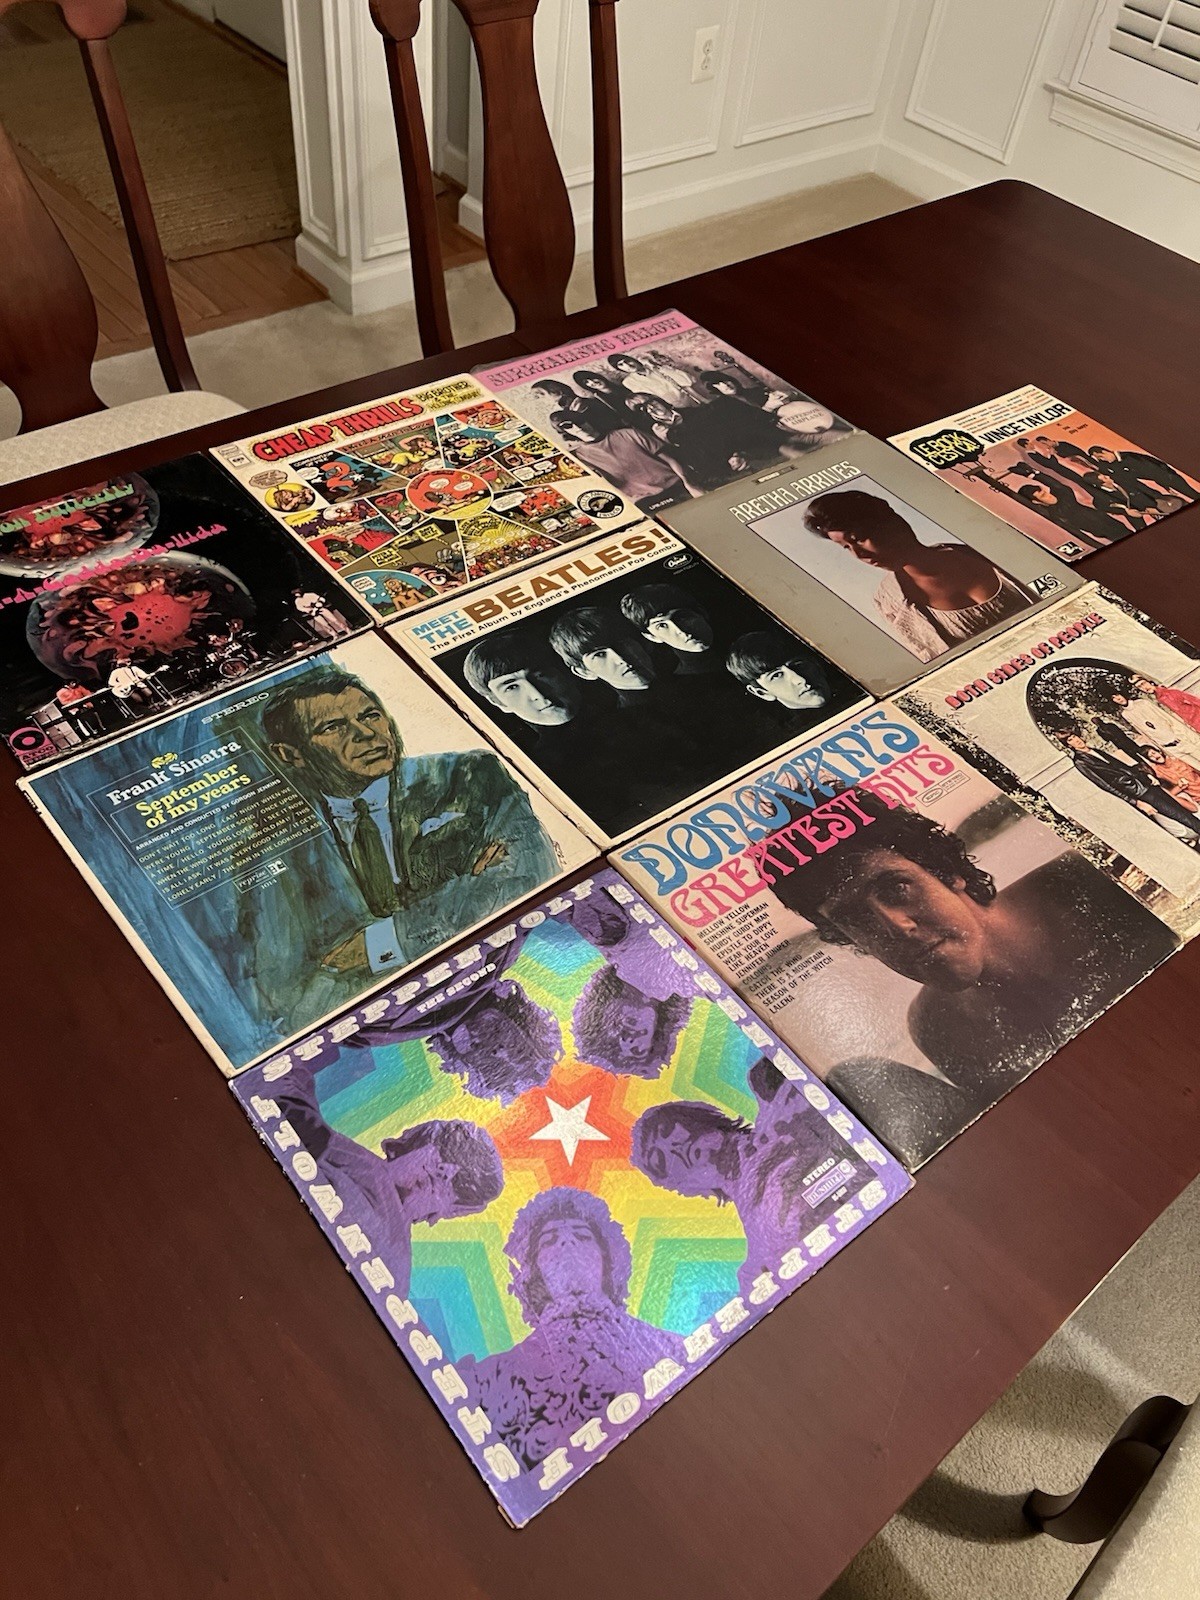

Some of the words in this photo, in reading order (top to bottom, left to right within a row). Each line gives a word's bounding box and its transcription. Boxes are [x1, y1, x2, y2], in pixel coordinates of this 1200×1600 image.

[489, 337, 615, 388] SURREALISTIC
[621, 318, 682, 350] PILLOW
[252, 425, 335, 462] CHEAP
[326, 397, 424, 436] THRILLS
[913, 443, 936, 457] LE
[978, 423, 1026, 444] VINCE
[1017, 403, 1072, 428] TAYLOR
[729, 487, 796, 523] ARETHA
[789, 461, 862, 498] ARRIVES
[430, 640, 450, 652] The
[452, 628, 476, 646] First
[478, 615, 509, 634] Album
[510, 608, 523, 621] by
[524, 589, 570, 612] England's
[571, 562, 627, 592] Phenomenal
[628, 554, 646, 569] Pop
[646, 542, 678, 558] Combo
[462, 528, 672, 624] BEATLES!
[412, 610, 460, 636] MEET
[420, 618, 474, 645] THE
[986, 653, 1037, 685] SIDES
[1030, 642, 1055, 659] OF
[1049, 612, 1107, 651] PEOPLE
[201, 692, 270, 725] STEREO
[106, 770, 172, 806] Frank
[171, 740, 242, 778] Sinatra
[136, 763, 240, 817] September
[135, 832, 169, 850] ARRANGED
[170, 826, 184, 834] AND
[184, 807, 221, 827] CONDUCTED
[231, 791, 256, 806] GORDON
[257, 779, 281, 793] JENKINS
[139, 849, 162, 862] DON'T
[162, 839, 180, 852] WAIT
[181, 832, 195, 842] TOO
[196, 823, 216, 836] LONG
[222, 812, 238, 823] LAST
[239, 802, 260, 815] NIGHT
[261, 791, 281, 804] WHEN
[145, 811, 165, 829] of
[165, 796, 198, 820] my
[198, 774, 251, 807] years
[620, 710, 921, 897] DONOVAN'S
[145, 858, 165, 871] WERE
[165, 845, 190, 860] YOUNG
[196, 823, 235, 845] SEPTEMBER
[236, 814, 256, 827] SONG
[260, 803, 279, 814] ONCE
[279, 793, 298, 805] UPON
[156, 873, 177, 886] WHEN
[177, 867, 189, 877] THE
[190, 858, 208, 870] WIND
[208, 850, 222, 861] WAS
[222, 840, 244, 854] GREEN
[248, 830, 263, 840] HOW
[263, 824, 276, 833] OLD
[295, 807, 310, 817] THIS
[158, 863, 176, 874] TIME
[207, 835, 232, 849] YOUNG
[232, 822, 259, 837] LOVERS
[268, 810, 281, 820] SEE
[288, 800, 304, 811] NOW
[170, 879, 183, 889] ALL
[188, 871, 202, 881] ASK
[214, 856, 229, 868] WAS
[235, 845, 252, 858] VERY
[252, 836, 271, 849] GOOD
[271, 828, 288, 840] YEAR
[299, 814, 317, 825] GETS
[669, 789, 878, 928] GREATEST
[859, 744, 955, 811] HITS
[168, 886, 194, 902] LONELY
[194, 874, 217, 888] EARLY
[222, 864, 235, 874] THE
[236, 857, 251, 868] MAN
[260, 845, 274, 855] THE
[274, 830, 303, 848] LOOKING
[238, 867, 270, 888] reprise
[697, 919, 725, 939] MELLOW
[725, 903, 750, 921] YELLOW
[704, 924, 736, 946] SUNSHINE
[737, 902, 769, 925] SUPERMAN
[710, 936, 732, 952] HURDY
[732, 922, 754, 938] GURDY
[754, 912, 770, 924] MAN
[716, 940, 743, 959] EPISTLE
[743, 934, 753, 942] TO
[753, 921, 773, 937] DIPPY
[722, 951, 743, 966] WEAR
[743, 939, 762, 953] YOUR
[762, 928, 778, 941] LOVE
[262, 878, 594, 1082] STEPPENWOLF
[728, 960, 744, 972] LIKE
[745, 943, 770, 961] HEAVEN
[736, 957, 765, 979] JENNIFER
[766, 939, 791, 960] JUNIPER
[742, 964, 772, 985] COLOURS
[749, 976, 771, 992] CATCH
[772, 965, 784, 977] THE
[785, 954, 802, 968] WIND
[756, 984, 780, 999] THERE
[779, 977, 785, 985] IS
[793, 950, 825, 972] MOUNTAIN
[762, 987, 788, 1007] SEASON
[789, 980, 798, 988] OF
[798, 970, 813, 982] THE
[813, 956, 833, 972] WITCH
[416, 993, 445, 1013] THE
[445, 963, 496, 996] SECOND
[769, 994, 795, 1014] LALENA
[606, 883, 887, 1166] STEPPENWOLF
[802, 1158, 835, 1186] STEREO
[250, 1095, 521, 1482] STEPPENWOLF
[538, 1179, 888, 1491] STEPPENWOLF
